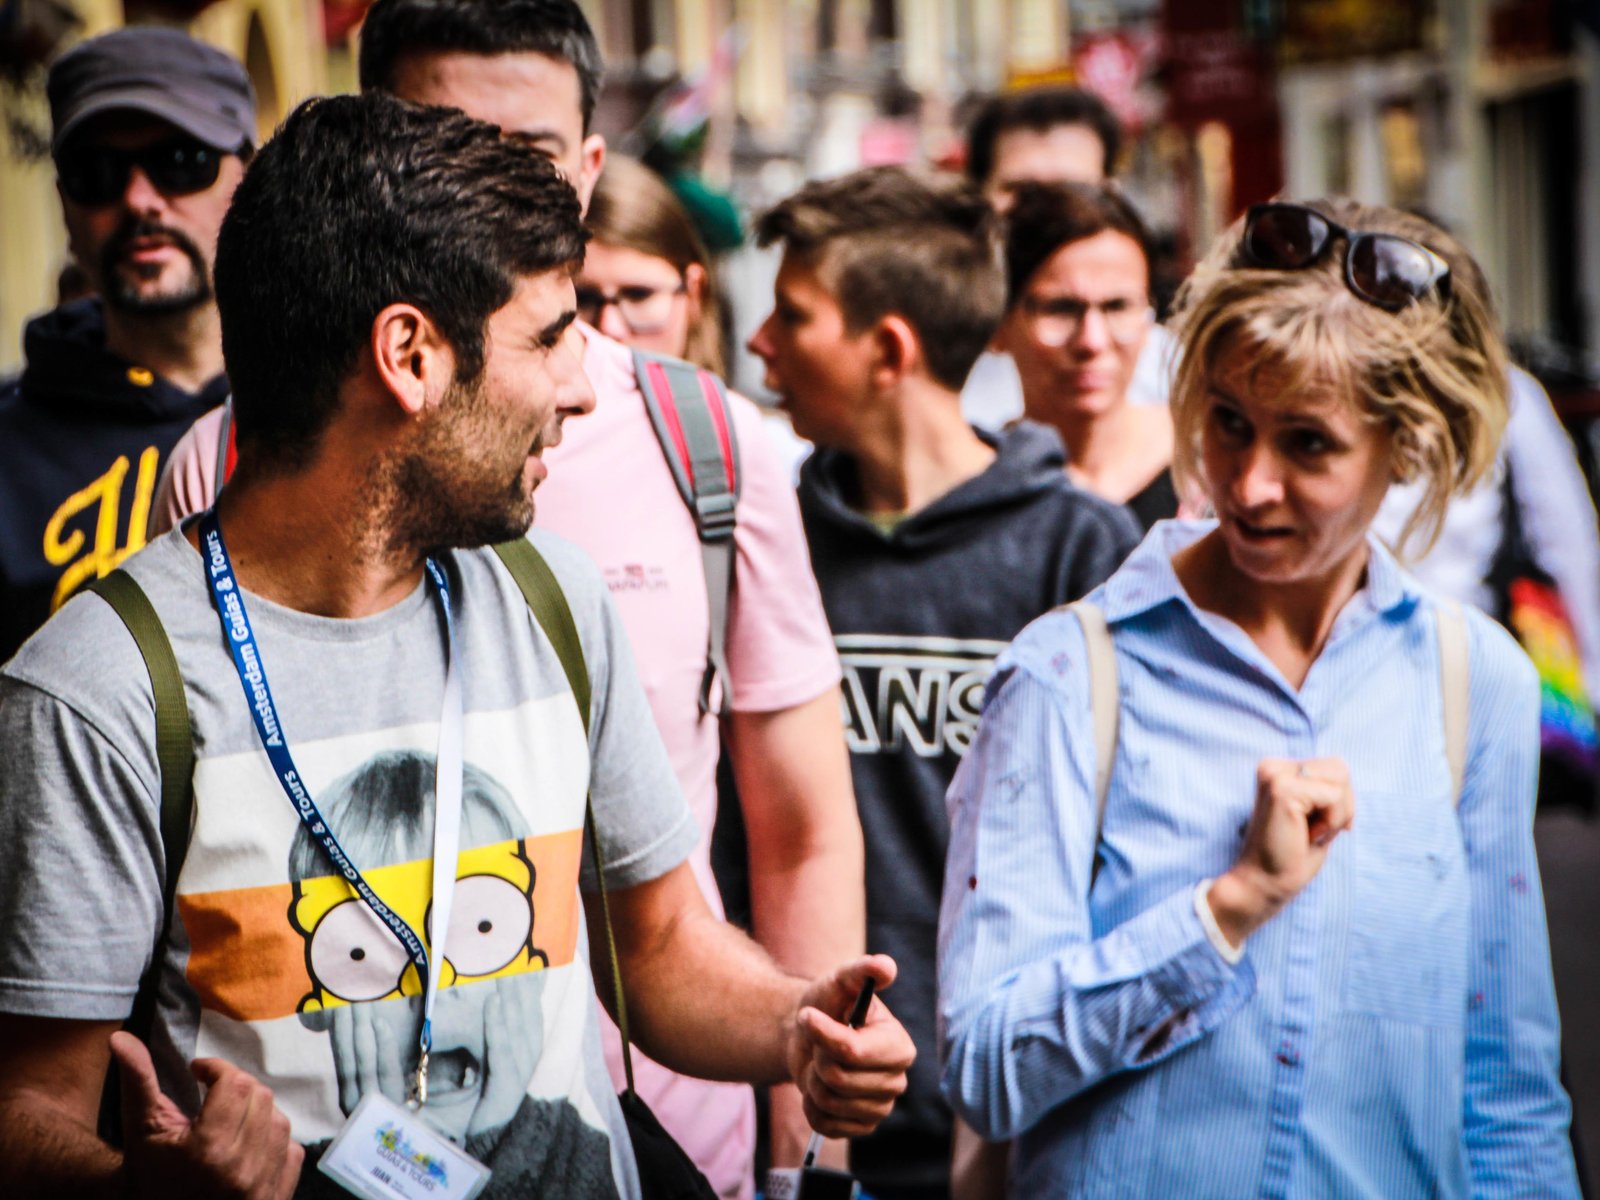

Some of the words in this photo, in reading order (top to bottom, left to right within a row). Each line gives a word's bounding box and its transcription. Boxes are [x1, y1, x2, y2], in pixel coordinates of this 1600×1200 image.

[206, 530, 228, 578] Tours
[216, 576, 234, 591] &
[240, 643, 283, 747] Amsterdam
[838, 662, 988, 757] ANS
[284, 770, 315, 821] Tours
[311, 821, 326, 835] &
[358, 882, 425, 965] Amsterdam
